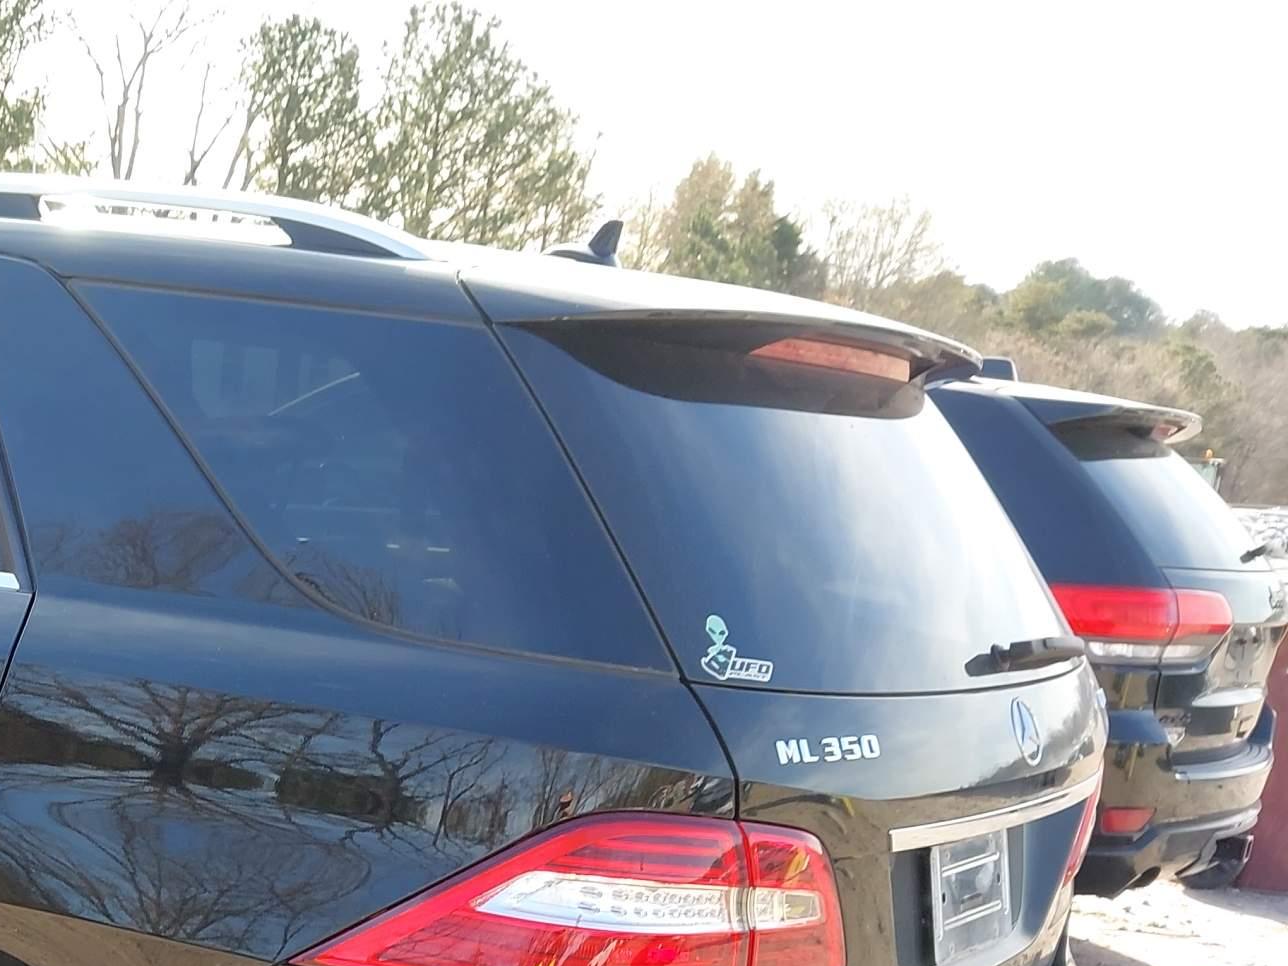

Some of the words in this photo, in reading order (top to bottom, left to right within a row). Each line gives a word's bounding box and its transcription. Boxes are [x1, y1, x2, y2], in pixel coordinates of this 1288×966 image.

[730, 660, 770, 674] UFO
[775, 738, 819, 765] ML
[820, 734, 881, 762] 350
